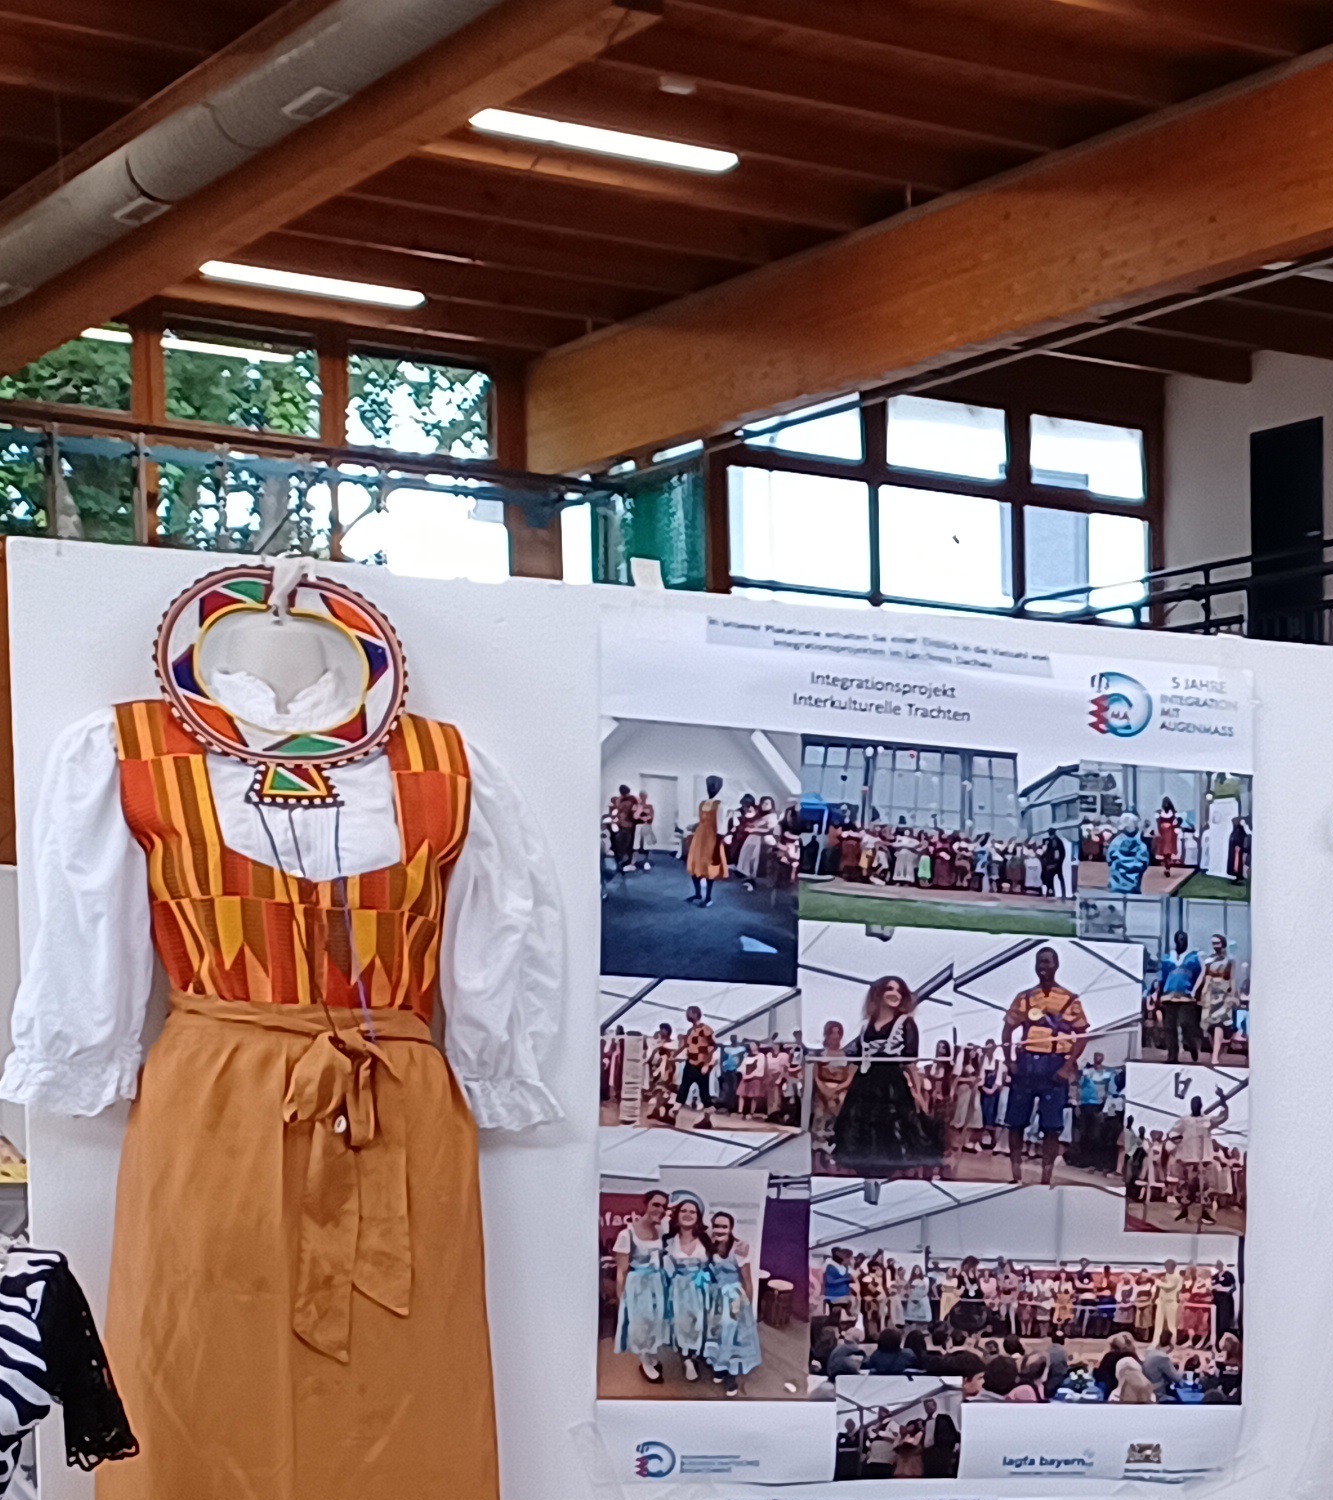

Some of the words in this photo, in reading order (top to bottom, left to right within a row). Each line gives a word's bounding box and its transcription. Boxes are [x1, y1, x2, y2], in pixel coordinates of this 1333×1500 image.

[810, 671, 957, 699] Integrationsprojekt
[1171, 676, 1181, 690] 5
[793, 692, 901, 716] Interkulturelle
[907, 703, 970, 722] Trachten
